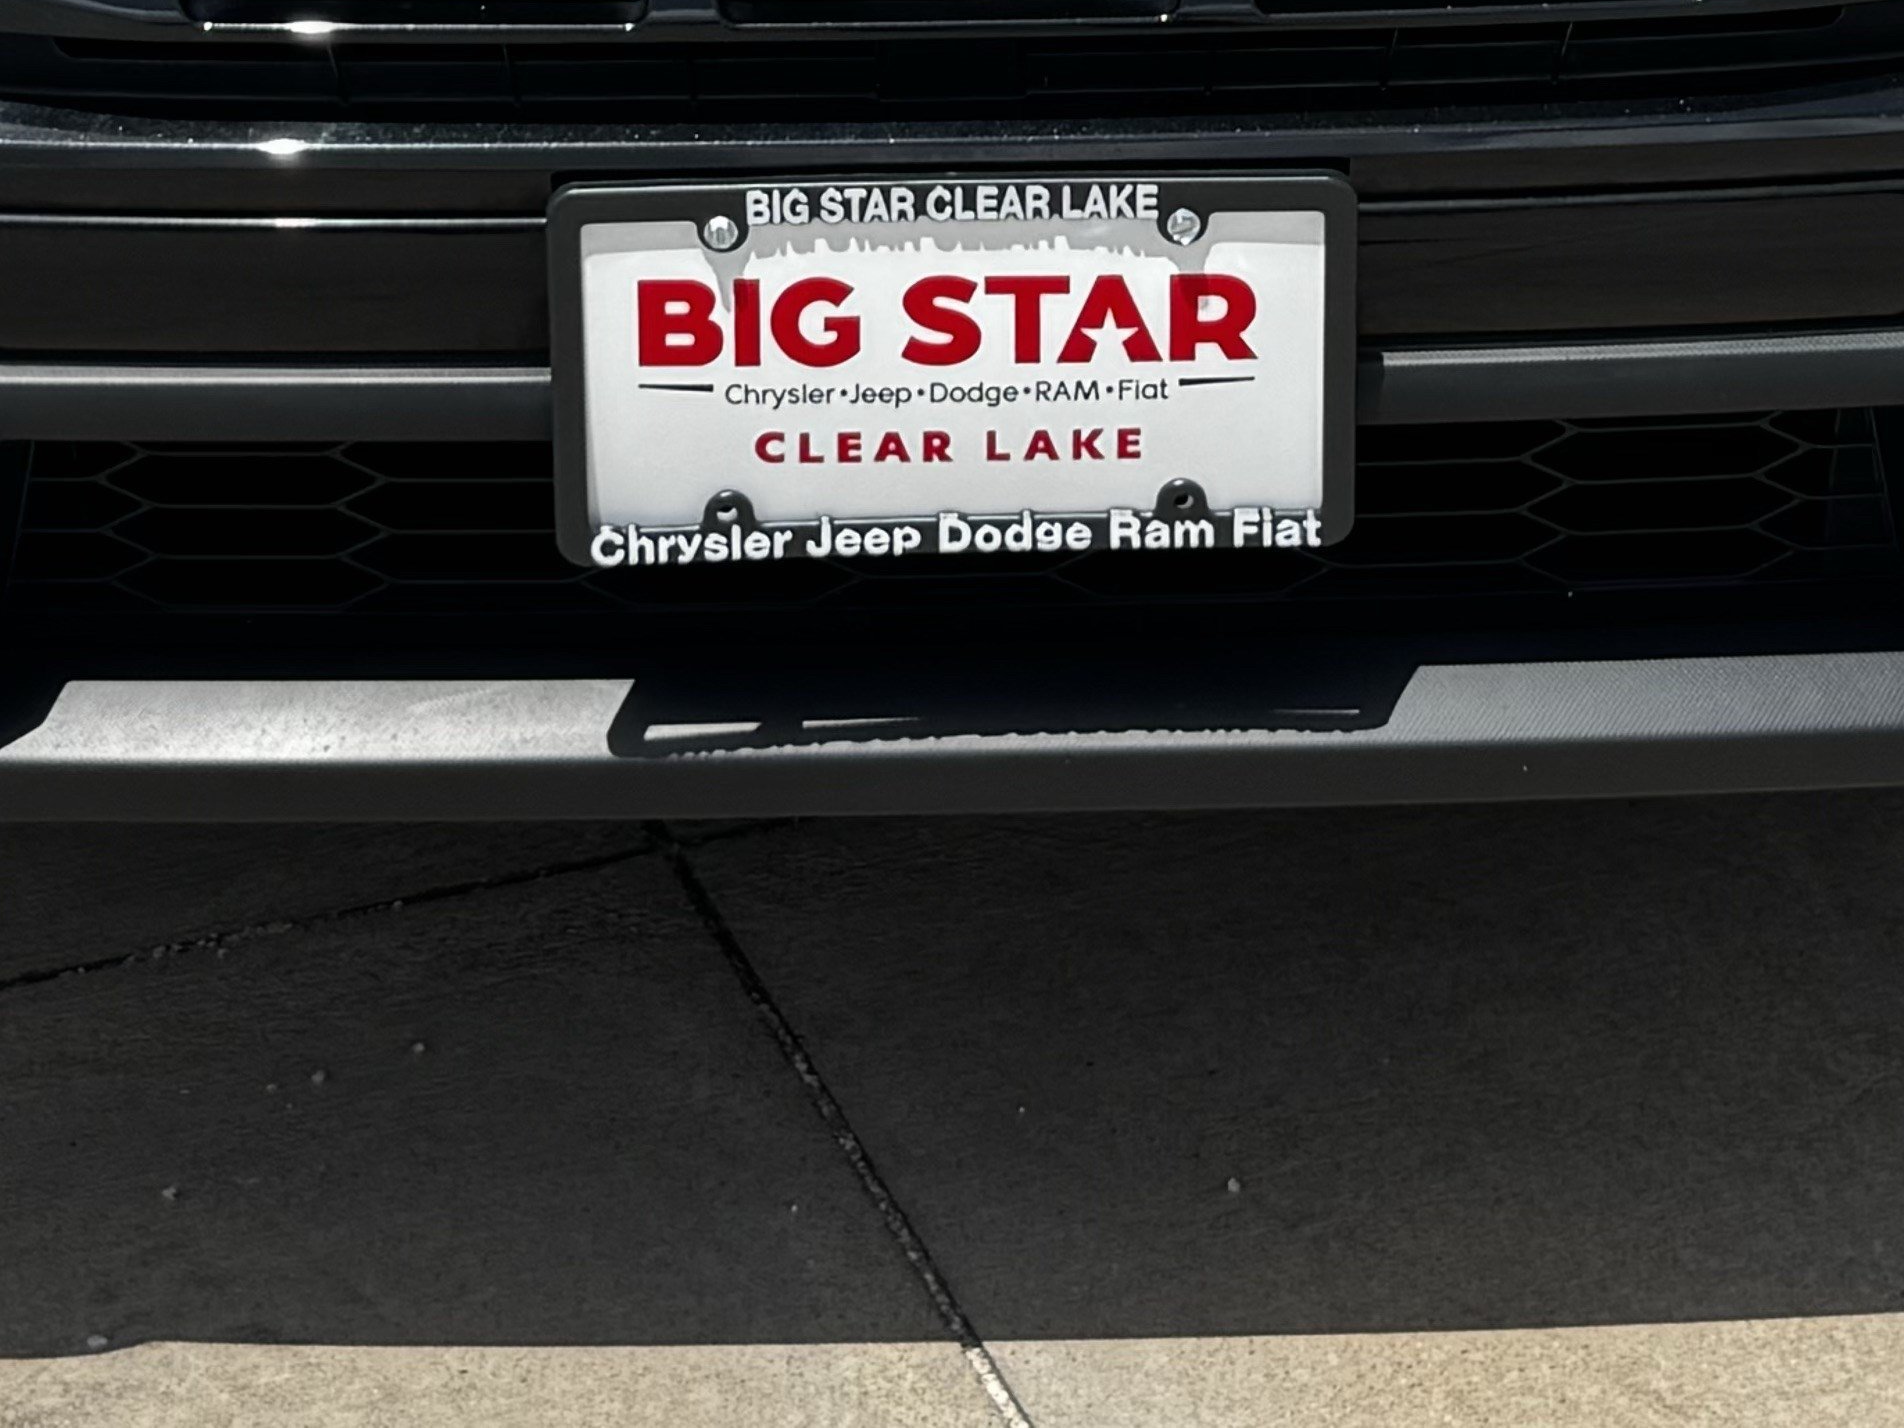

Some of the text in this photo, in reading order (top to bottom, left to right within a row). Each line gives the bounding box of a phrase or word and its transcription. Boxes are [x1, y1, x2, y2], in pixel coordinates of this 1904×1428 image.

[744, 184, 1160, 225] BIG STAR CLEAR LAKE
[636, 274, 1259, 369] BIG STAR
[725, 383, 836, 410] Chrysler
[849, 383, 913, 409] Jeep
[929, 381, 1020, 407] Dodge
[1035, 380, 1100, 402] RAM
[755, 428, 1143, 464] CLEAR LAKE
[590, 506, 1322, 568] Chrysler Jeep Dodge Ram Fiat
